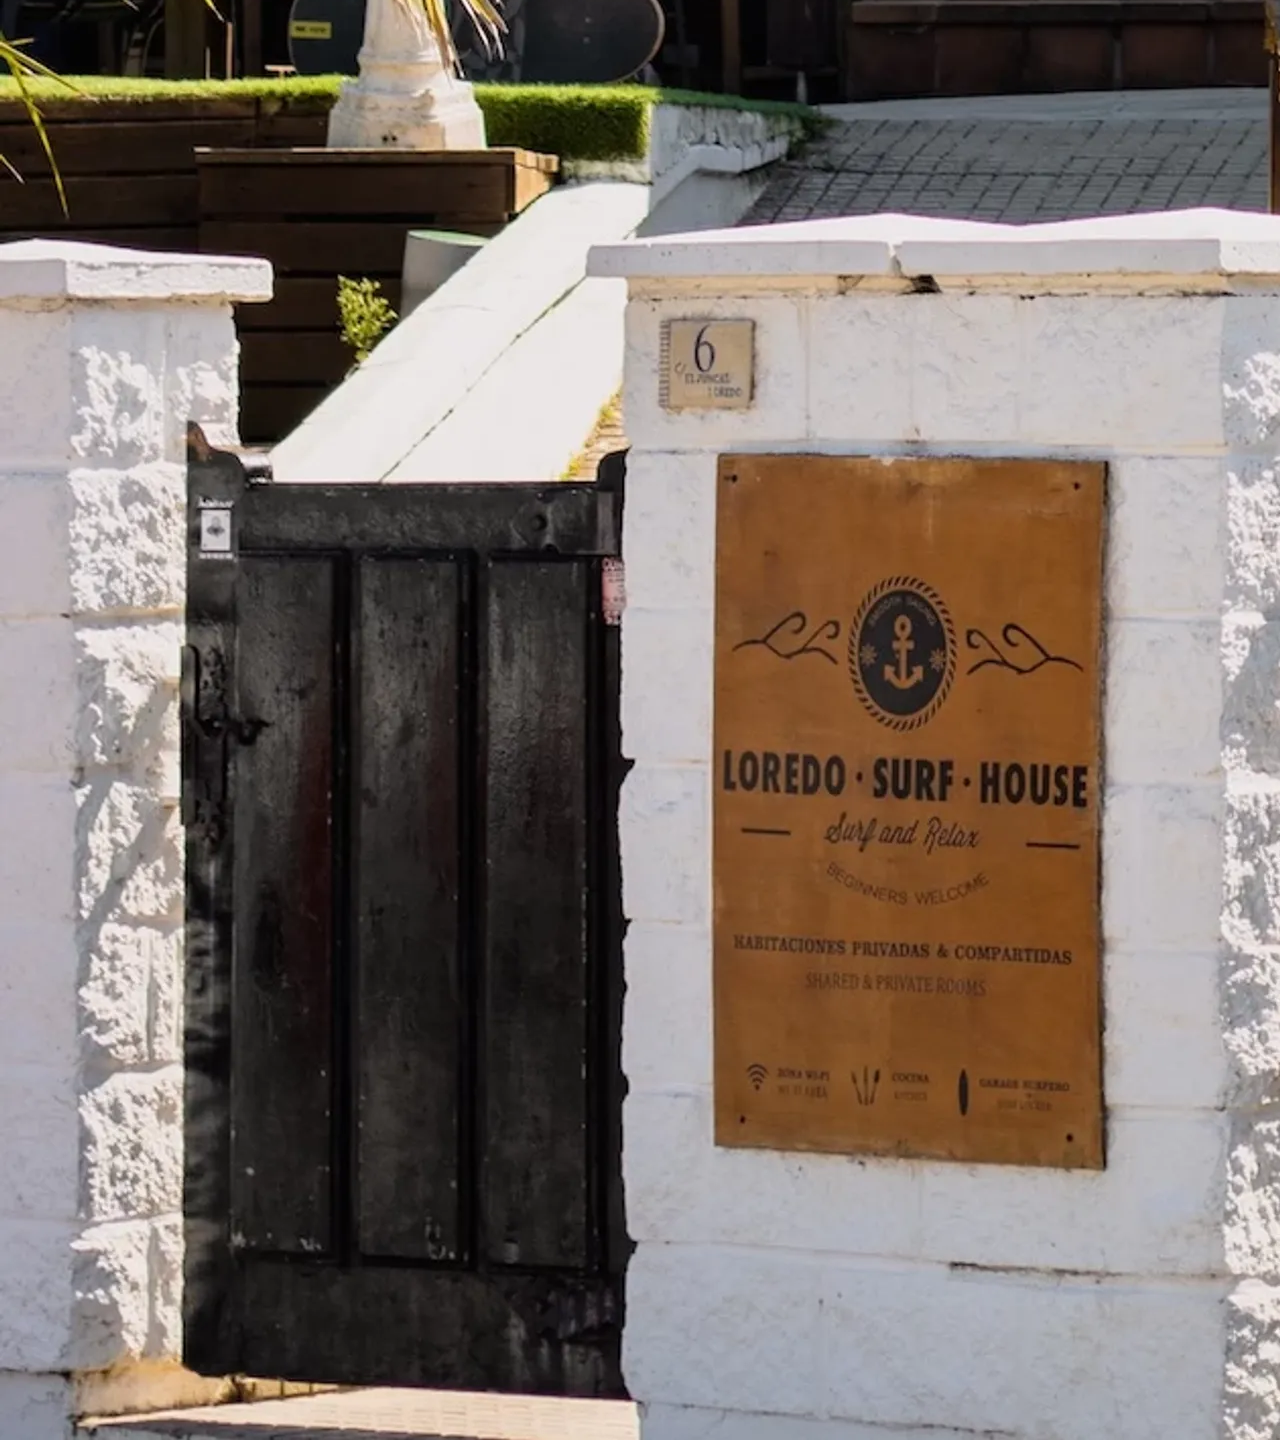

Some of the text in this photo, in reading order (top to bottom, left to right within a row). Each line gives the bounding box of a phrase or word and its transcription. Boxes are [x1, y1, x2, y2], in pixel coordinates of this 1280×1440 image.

[694, 322, 715, 373] 6
[723, 749, 1089, 808] LOREDO SURF HOUSE
[823, 812, 981, 855] Surf and Relax
[826, 861, 991, 907] BEGINNERS WELCOME
[734, 934, 1073, 966] HABITACIONES PRIVADAS & COMPARTIDAS
[805, 971, 987, 997] SHARED & PRIVATE ROOMS
